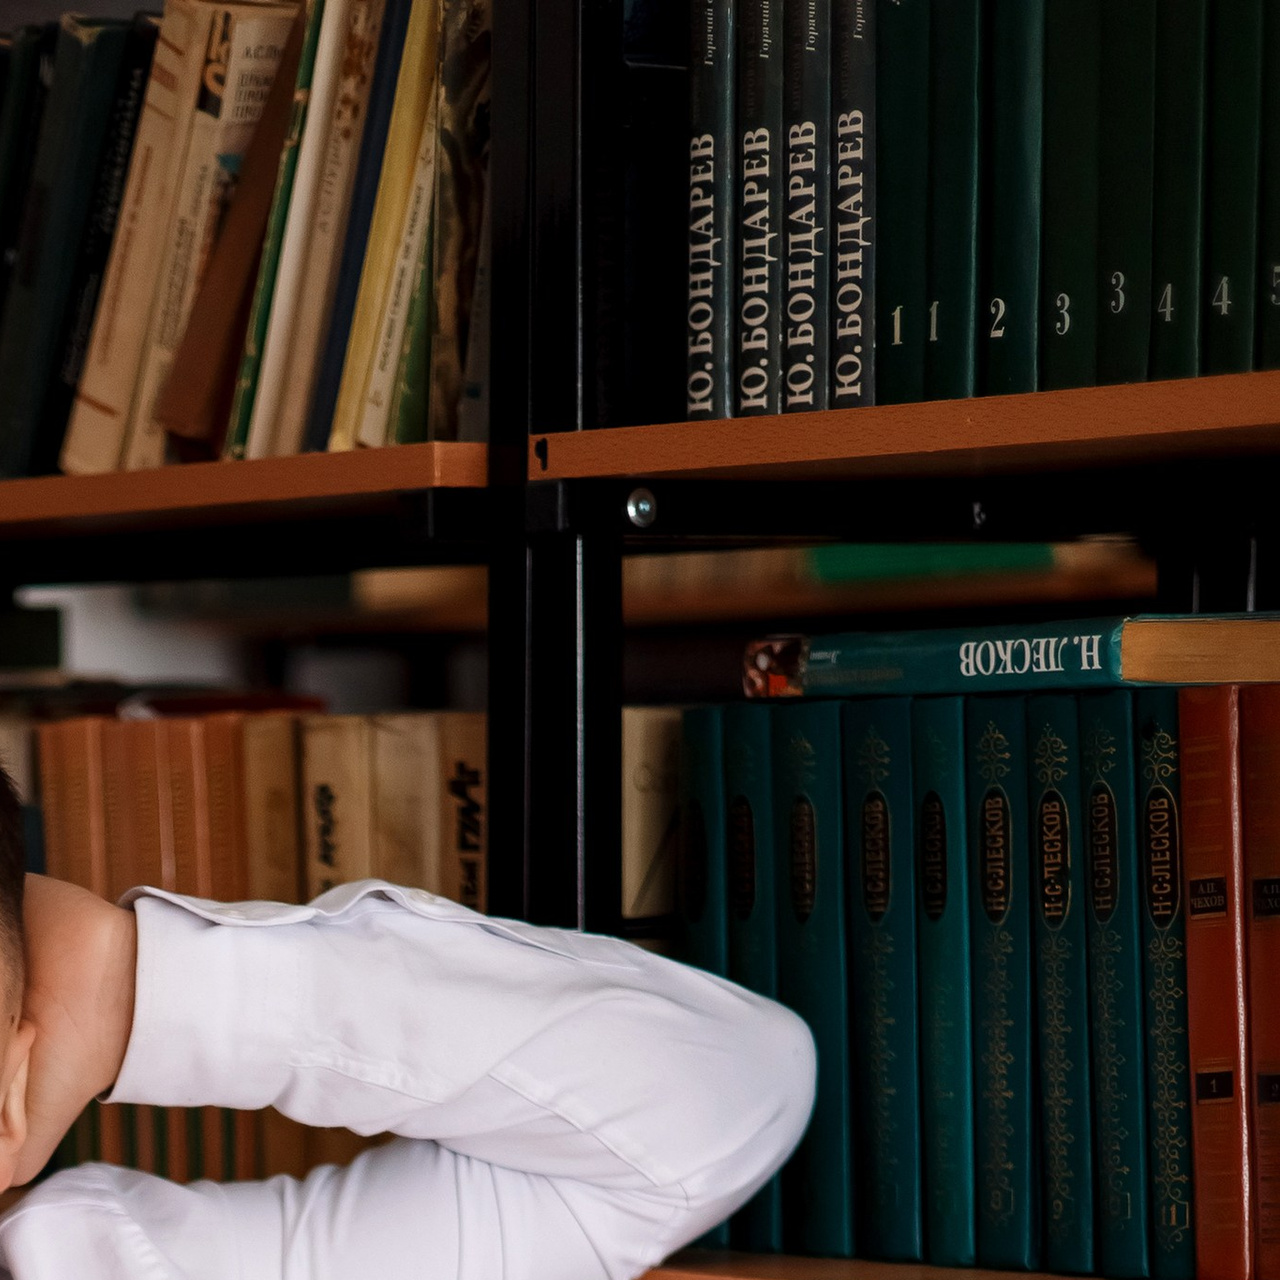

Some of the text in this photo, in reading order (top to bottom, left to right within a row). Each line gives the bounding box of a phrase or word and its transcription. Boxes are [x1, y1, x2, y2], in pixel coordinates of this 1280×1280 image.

[805, 0, 819, 51] Горячи
[687, 133, 722, 414] Ю. БОНДАРЕВ
[740, 127, 779, 411] Ю. БОНДАРЕВ
[786, 121, 824, 408] Ю. БОНДАРЕВ
[835, 109, 872, 399] Ю. БОНДАРЕВ
[1055, 292, 1071, 336] 3
[1110, 271, 1126, 314] 3
[1156, 282, 1175, 322] 4
[1211, 275, 1232, 316] 4
[890, 304, 904, 346] 1
[928, 300, 940, 342] 1
[989, 297, 1006, 339] 2
[958, 634, 1103, 677] Н. ЛЕСКОВ
[1210, 1078, 1218, 1093] 1
